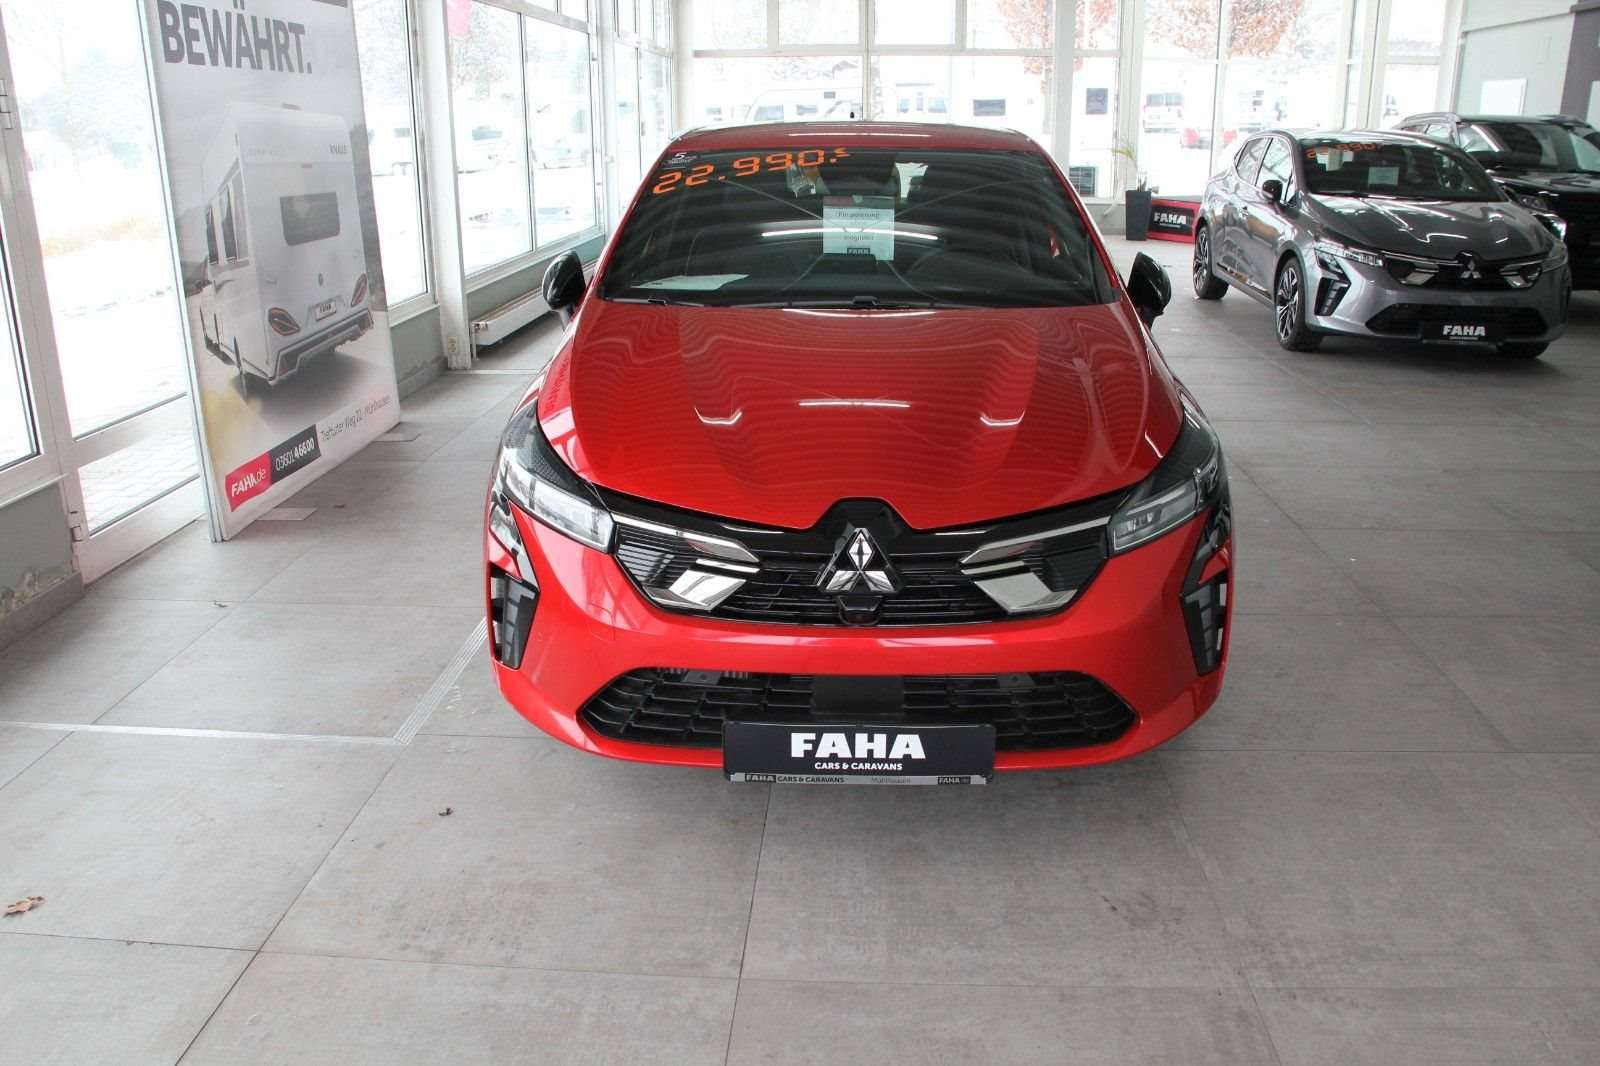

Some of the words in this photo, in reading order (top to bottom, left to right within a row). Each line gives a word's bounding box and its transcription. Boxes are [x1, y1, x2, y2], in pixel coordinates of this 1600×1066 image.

[157, 0, 313, 74] BEWÄHRT.
[1153, 212, 1187, 225] FAHA
[1442, 324, 1486, 336] FAHA
[231, 469, 266, 497] FAHA.de
[791, 732, 926, 759] FAHA
[814, 762, 840, 770] CARS
[851, 762, 903, 771] CARAVANS
[746, 774, 774, 783] FAHA
